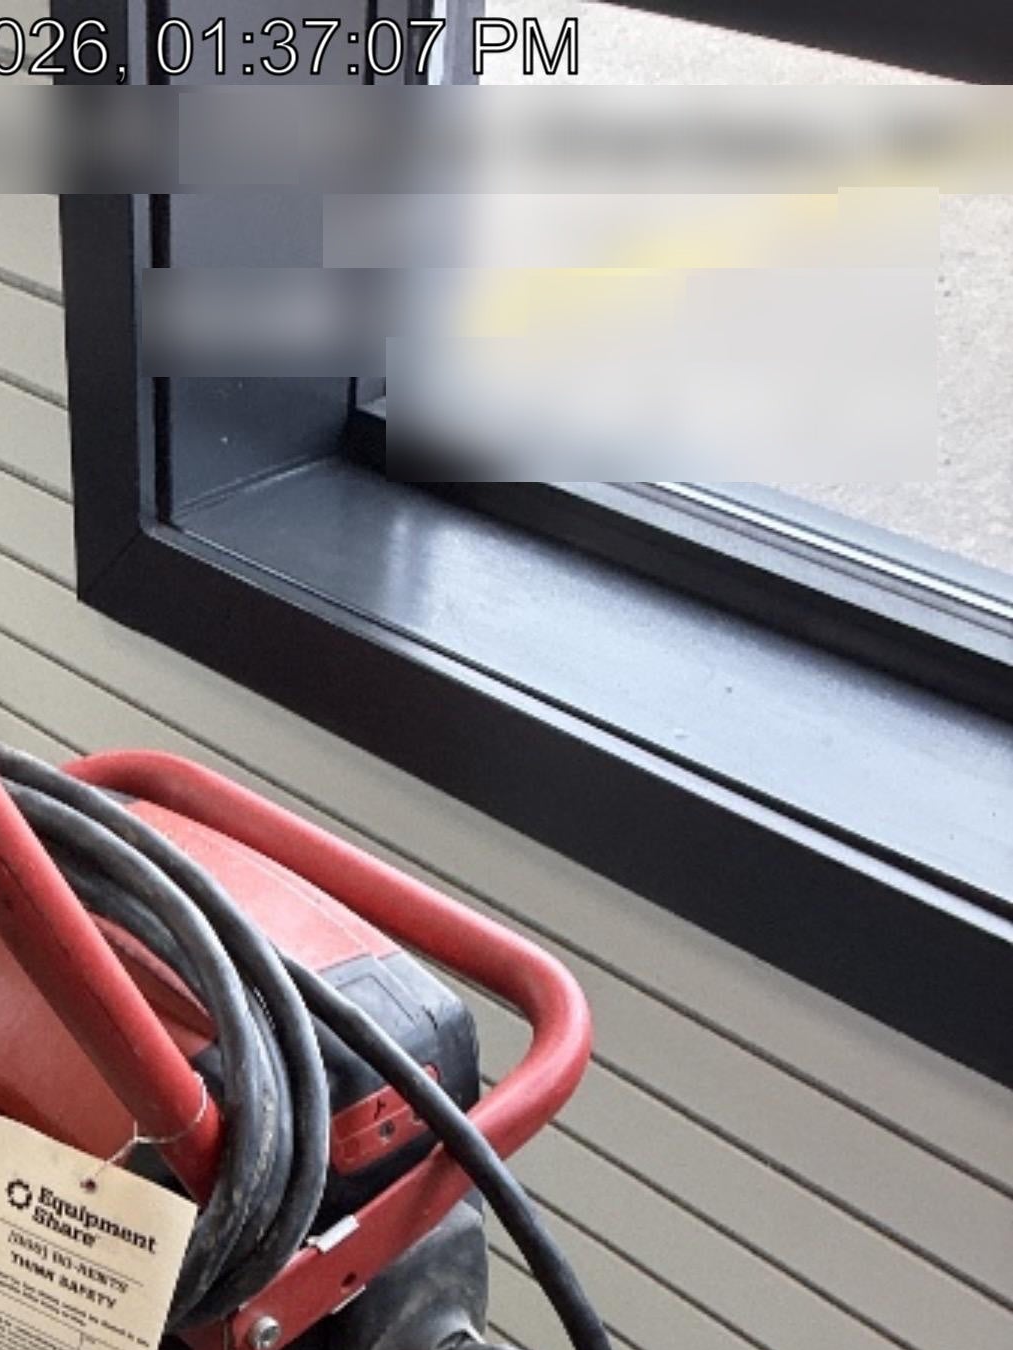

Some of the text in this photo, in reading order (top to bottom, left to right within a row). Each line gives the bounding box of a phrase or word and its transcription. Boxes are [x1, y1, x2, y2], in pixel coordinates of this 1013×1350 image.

[32, 1205, 98, 1248] Share
[38, 1185, 158, 1254] Equipment
[58, 1274, 118, 1310] SAFETY
